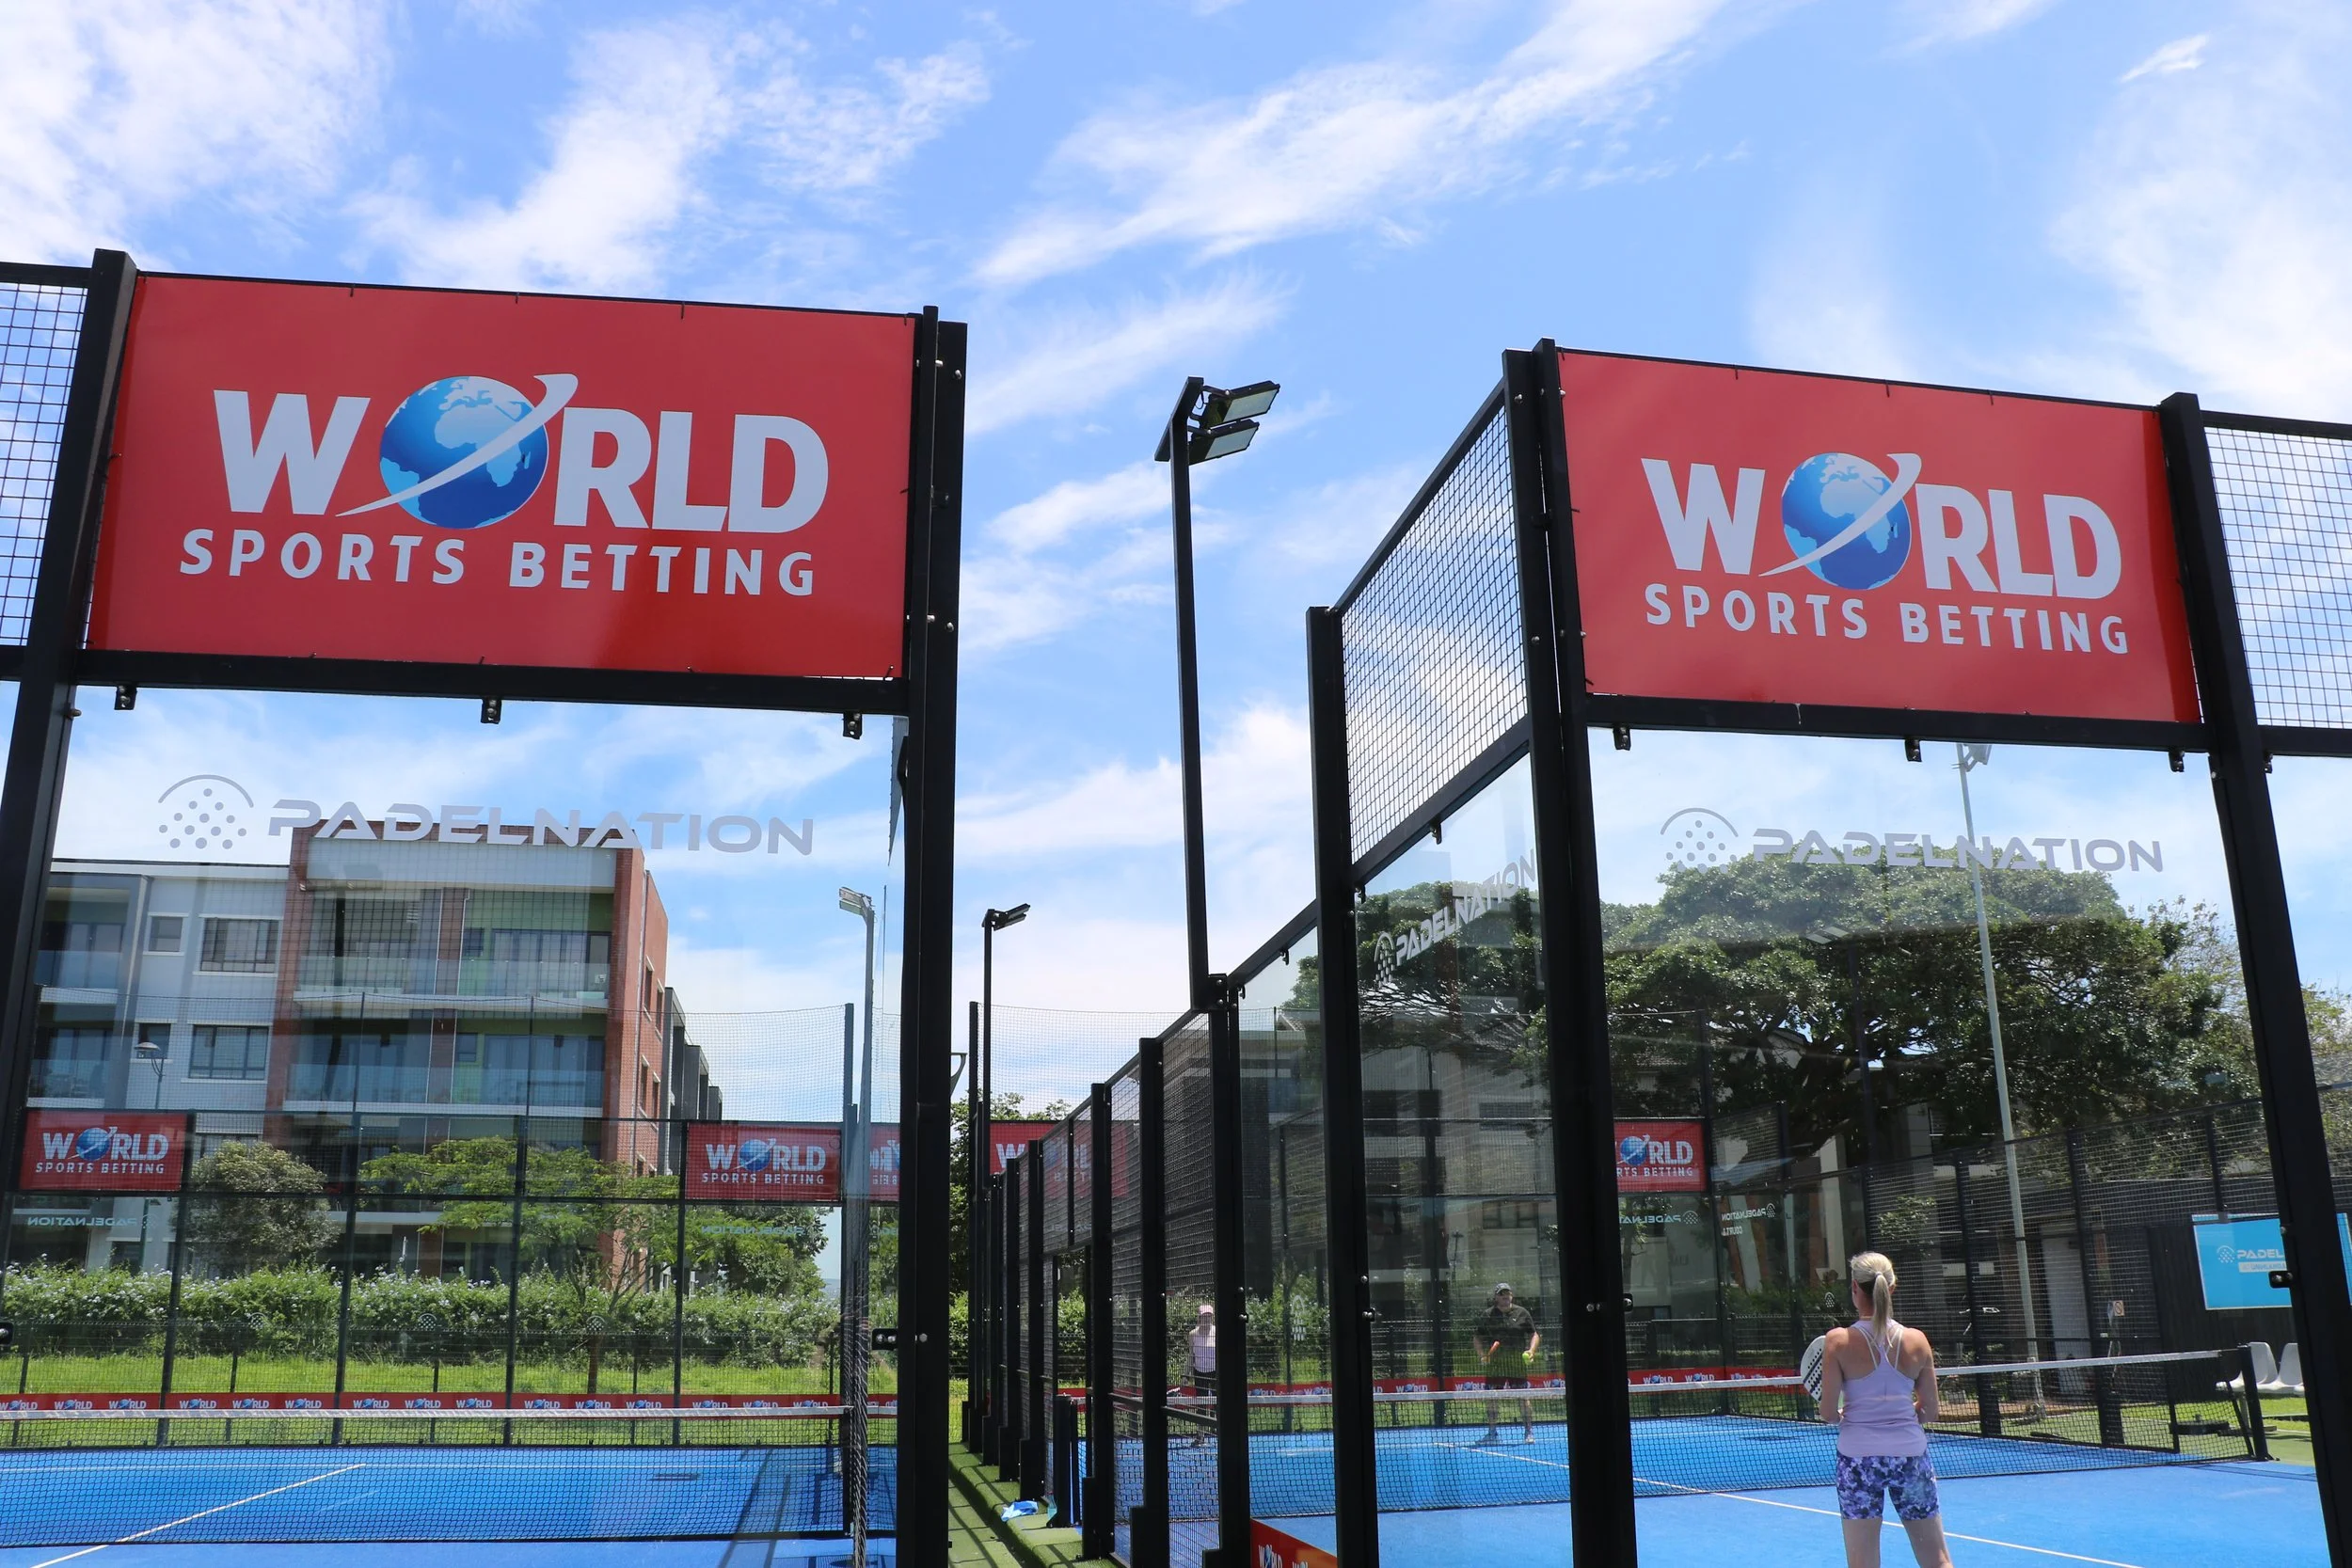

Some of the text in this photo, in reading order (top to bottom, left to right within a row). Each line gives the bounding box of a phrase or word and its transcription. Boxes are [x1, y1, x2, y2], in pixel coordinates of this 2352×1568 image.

[214, 373, 828, 532] WORLD
[1641, 452, 2122, 599] WORLD
[180, 529, 814, 596] SPORTS BETTING
[1645, 583, 2128, 654] SPORTS BETTING
[268, 799, 813, 856] PADELNATION
[1753, 828, 2163, 873] PADELNATION
[1395, 848, 1535, 967] PADELNATION
[42, 1127, 169, 1161] WORLD
[706, 1138, 826, 1172] WORLD
[35, 1162, 165, 1174] SPORTS BETTING
[702, 1172, 824, 1185] SPORTS BETTING
[1644, 1166, 1693, 1177] BETTING
[55, 1399, 92, 1410] WORLD
[109, 1398, 147, 1409] WORLD
[180, 1398, 322, 1409] WORLD WORLD WORLD
[353, 1398, 492, 1408] WORLD WORLD WORLD
[524, 1399, 661, 1409] WORLD WORLD WORLD
